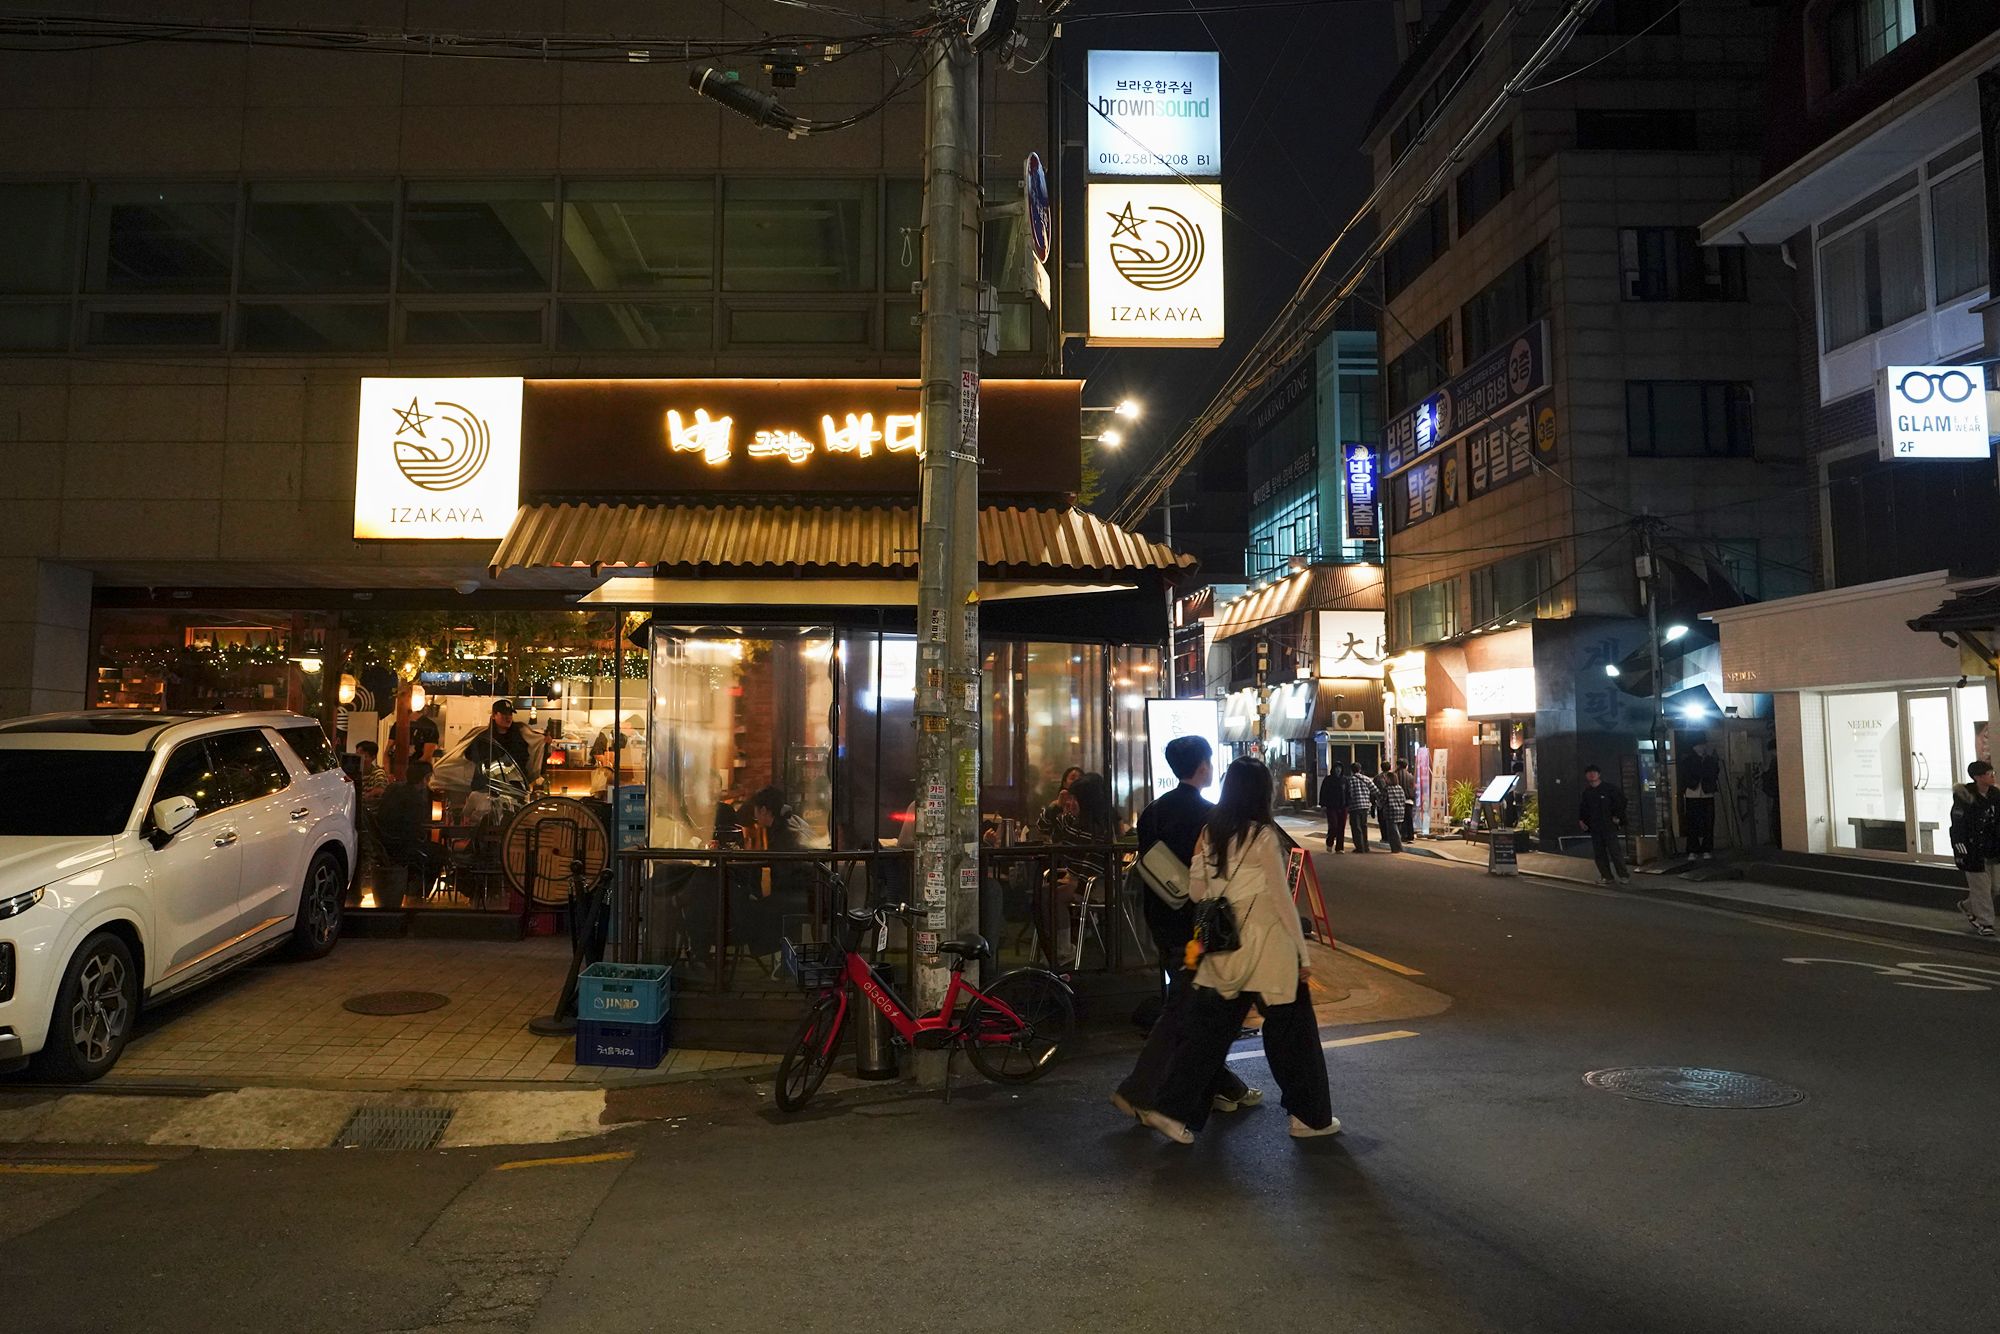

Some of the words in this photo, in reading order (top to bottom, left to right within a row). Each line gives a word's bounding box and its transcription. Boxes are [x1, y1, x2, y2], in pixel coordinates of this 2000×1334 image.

[1116, 80, 1192, 94] 브라운합주실
[1099, 96, 1209, 118] brownsound
[1099, 153, 1188, 165] 010.2581.3208
[1197, 155, 1211, 165] B1
[1111, 307, 1202, 322] IZAKAYA
[1387, 403, 1431, 469] 방탈출
[1511, 349, 1529, 388] 3층
[1898, 415, 1951, 432] GLAM
[1955, 424, 1981, 432] WEAR
[1900, 441, 1915, 453] 2F
[1349, 461, 1374, 526] 방탈출
[390, 507, 484, 523] IZAKAYA
[1847, 720, 1882, 729] NEEDLES
